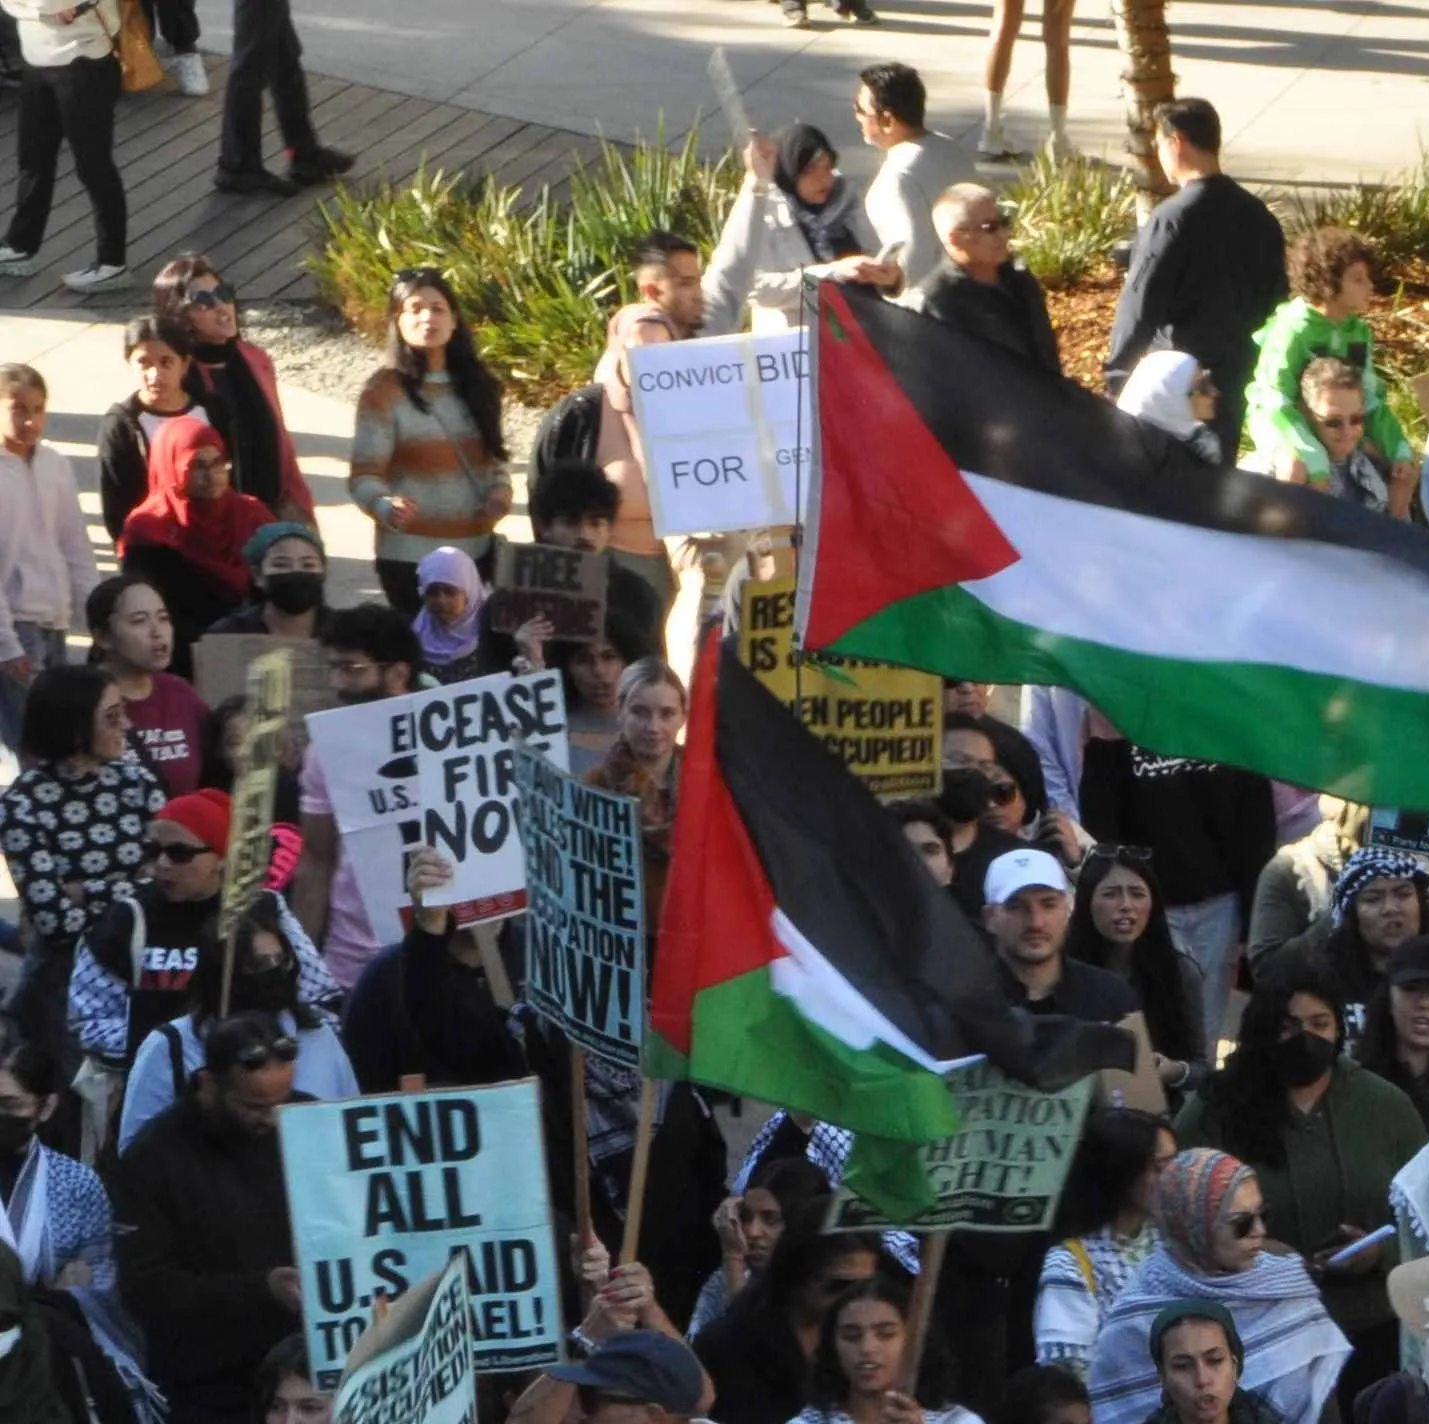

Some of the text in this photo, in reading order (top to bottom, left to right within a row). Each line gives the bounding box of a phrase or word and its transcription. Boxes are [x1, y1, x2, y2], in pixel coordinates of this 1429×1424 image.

[638, 363, 744, 392] CONVICT
[671, 456, 748, 489] FOR
[514, 546, 584, 593] FREE
[419, 678, 564, 752] CEASE
[836, 697, 935, 729] PEOPLE
[570, 781, 632, 838] WITH
[570, 858, 638, 930] THE
[530, 914, 633, 1041] NOW!
[342, 1098, 482, 1171] END
[925, 1129, 1073, 1162] HUMAN
[365, 1167, 481, 1238] ALL
